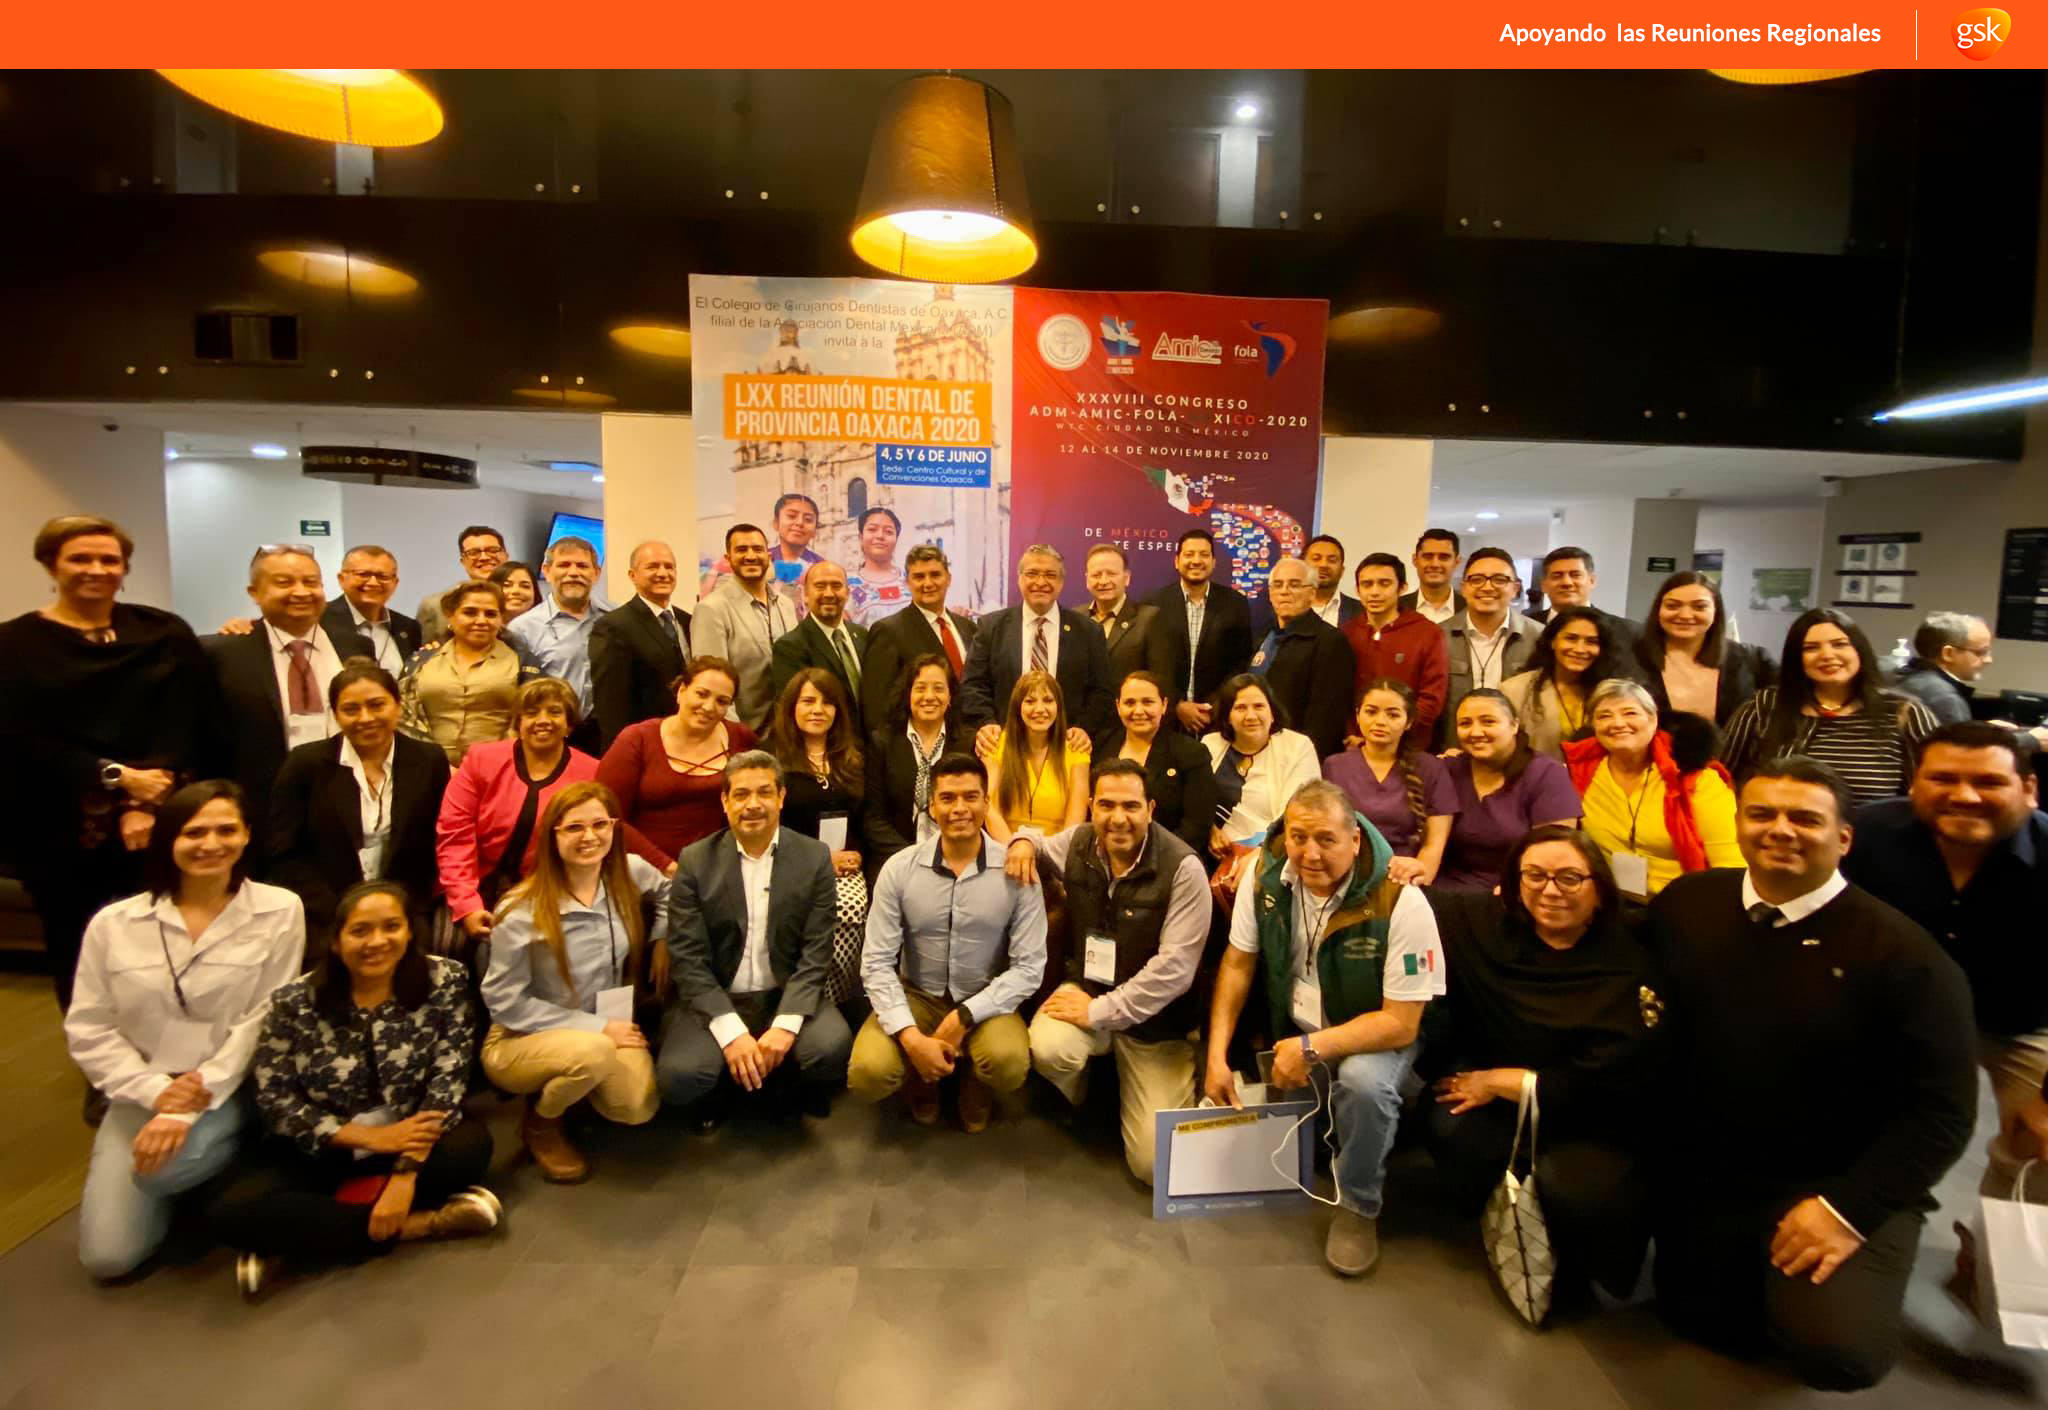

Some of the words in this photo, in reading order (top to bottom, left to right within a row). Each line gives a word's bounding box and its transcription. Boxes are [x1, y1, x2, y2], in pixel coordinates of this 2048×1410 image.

[695, 296, 708, 309] El
[712, 297, 761, 313] Colegio
[765, 299, 780, 311] de
[784, 300, 845, 314] Cirujanos
[849, 300, 906, 316] Dentistas
[910, 306, 926, 317] de
[740, 316, 755, 328] de
[759, 316, 770, 328] la
[845, 318, 886, 332] Dental
[824, 336, 857, 346] invita
[860, 338, 868, 347] a
[872, 337, 883, 348] la
[1233, 344, 1258, 358] fola
[735, 382, 775, 408] LXX
[781, 379, 866, 409] REUNIÓN
[872, 384, 945, 414] DENTAL
[950, 389, 976, 415] DE
[1076, 392, 1144, 405] XXXVIII
[1154, 394, 1248, 410] CONGRESO
[735, 410, 841, 436] PROVINCIA
[845, 412, 924, 439] OAXACA
[930, 416, 980, 442] 2020
[1096, 424, 1153, 432] CIUDAD
[1164, 426, 1180, 434] DE
[1192, 427, 1249, 437] MÉXICO
[880, 447, 892, 461] 4,
[895, 448, 904, 460] 5
[906, 448, 915, 461] Y
[918, 449, 925, 462] 6
[928, 450, 945, 462] DE
[947, 450, 987, 463] JUNIO
[1060, 444, 1074, 453] 12
[1081, 445, 1097, 454] AL
[1104, 446, 1119, 454] 14
[1126, 446, 1143, 454] DE
[1150, 446, 1230, 459] NOVIEMBRE
[1237, 450, 1269, 460] 2020
[882, 473, 939, 482] Convenciones
[906, 466, 935, 474] Centro
[936, 467, 967, 475] Cultural
[1084, 527, 1103, 537] DE
[1111, 526, 1169, 538] MÉXICO
